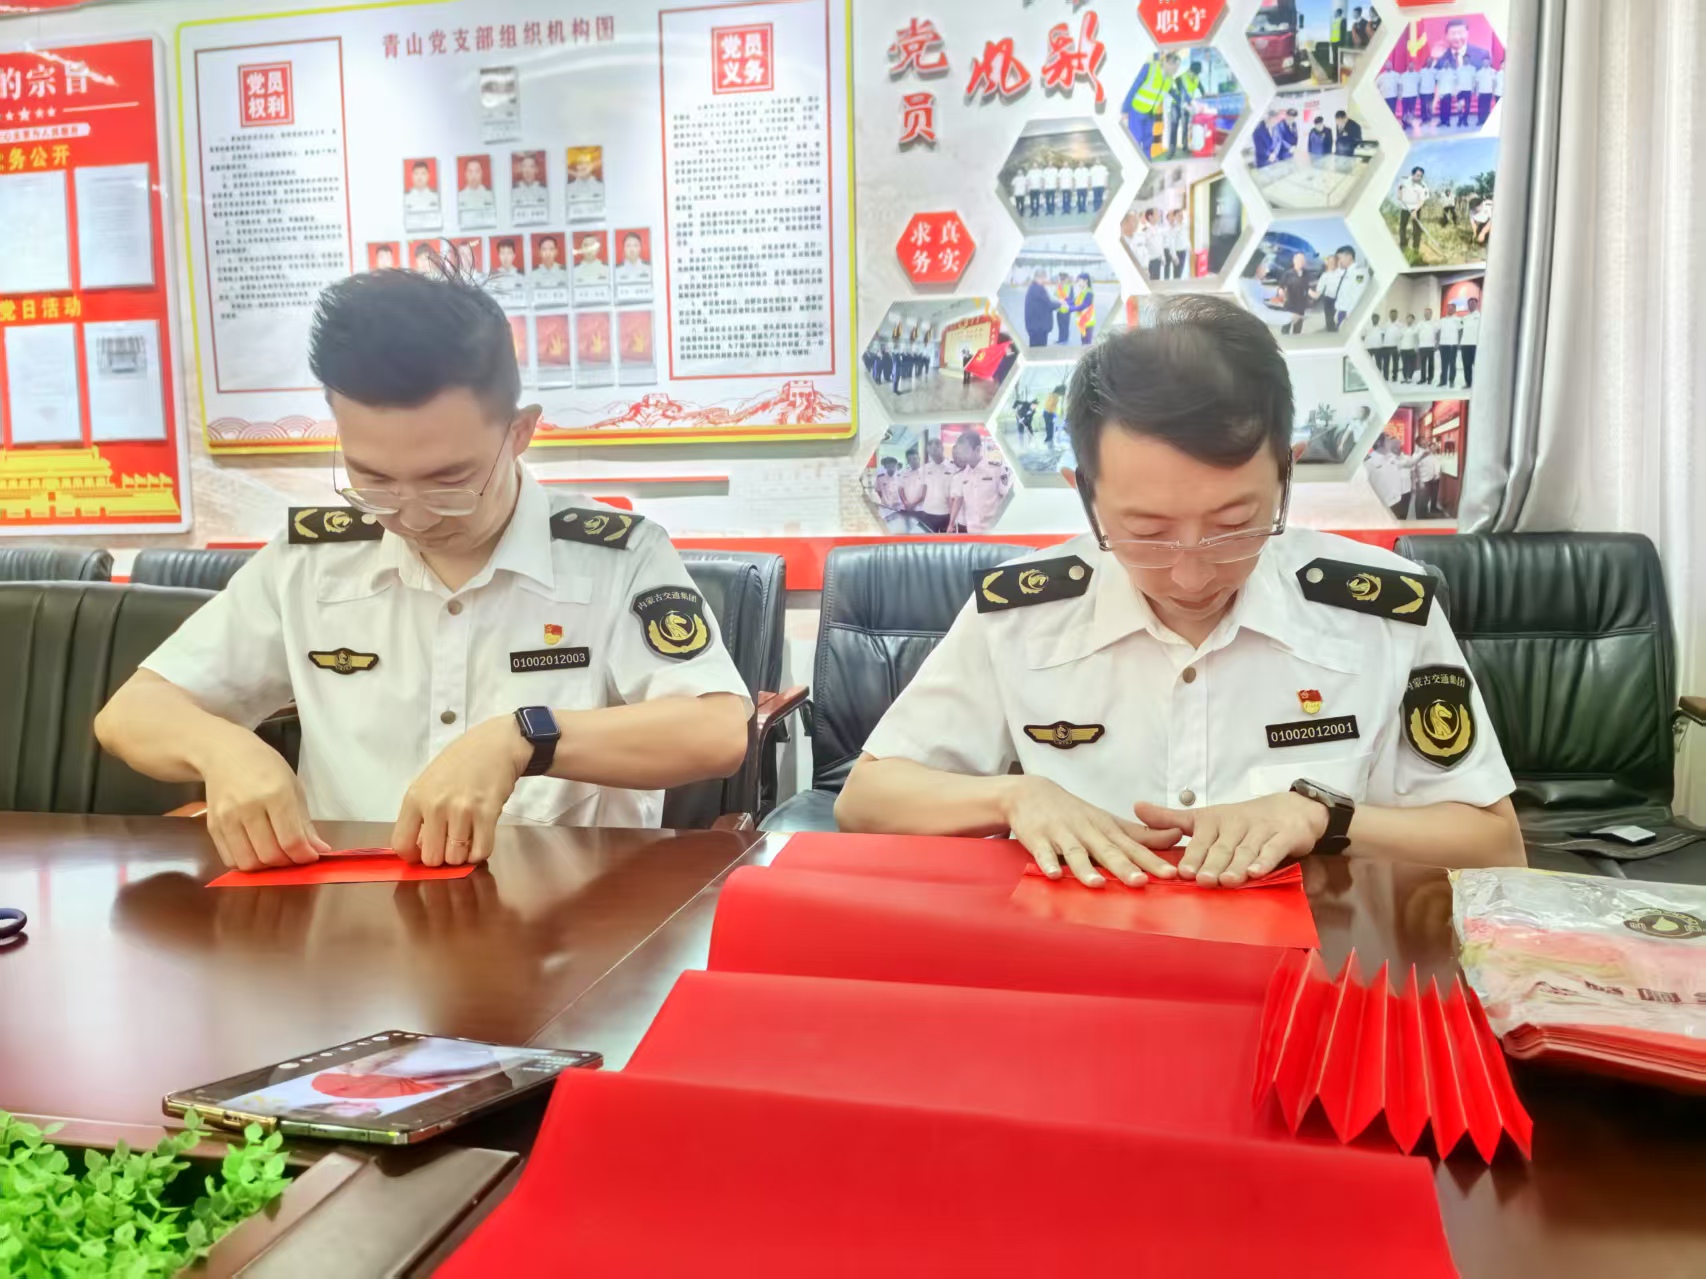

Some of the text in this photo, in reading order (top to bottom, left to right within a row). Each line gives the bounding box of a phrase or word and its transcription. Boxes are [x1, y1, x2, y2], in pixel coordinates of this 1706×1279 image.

[1155, 6, 1206, 34] 职守
[382, 15, 615, 59] 青山党支部组织机构图
[721, 33, 763, 60] 党员
[247, 71, 284, 95] 党员
[722, 60, 764, 86] 义务
[888, 17, 949, 143] 党员
[248, 95, 285, 119] 权利
[0, 144, 70, 171] 务公开
[910, 221, 961, 246] 求真
[911, 247, 961, 274] 务实
[0, 296, 82, 321] 党日活动
[637, 591, 697, 610] 内蒙古交通集团
[513, 652, 586, 668] 01002012003
[1270, 722, 1354, 743] 01002012001
